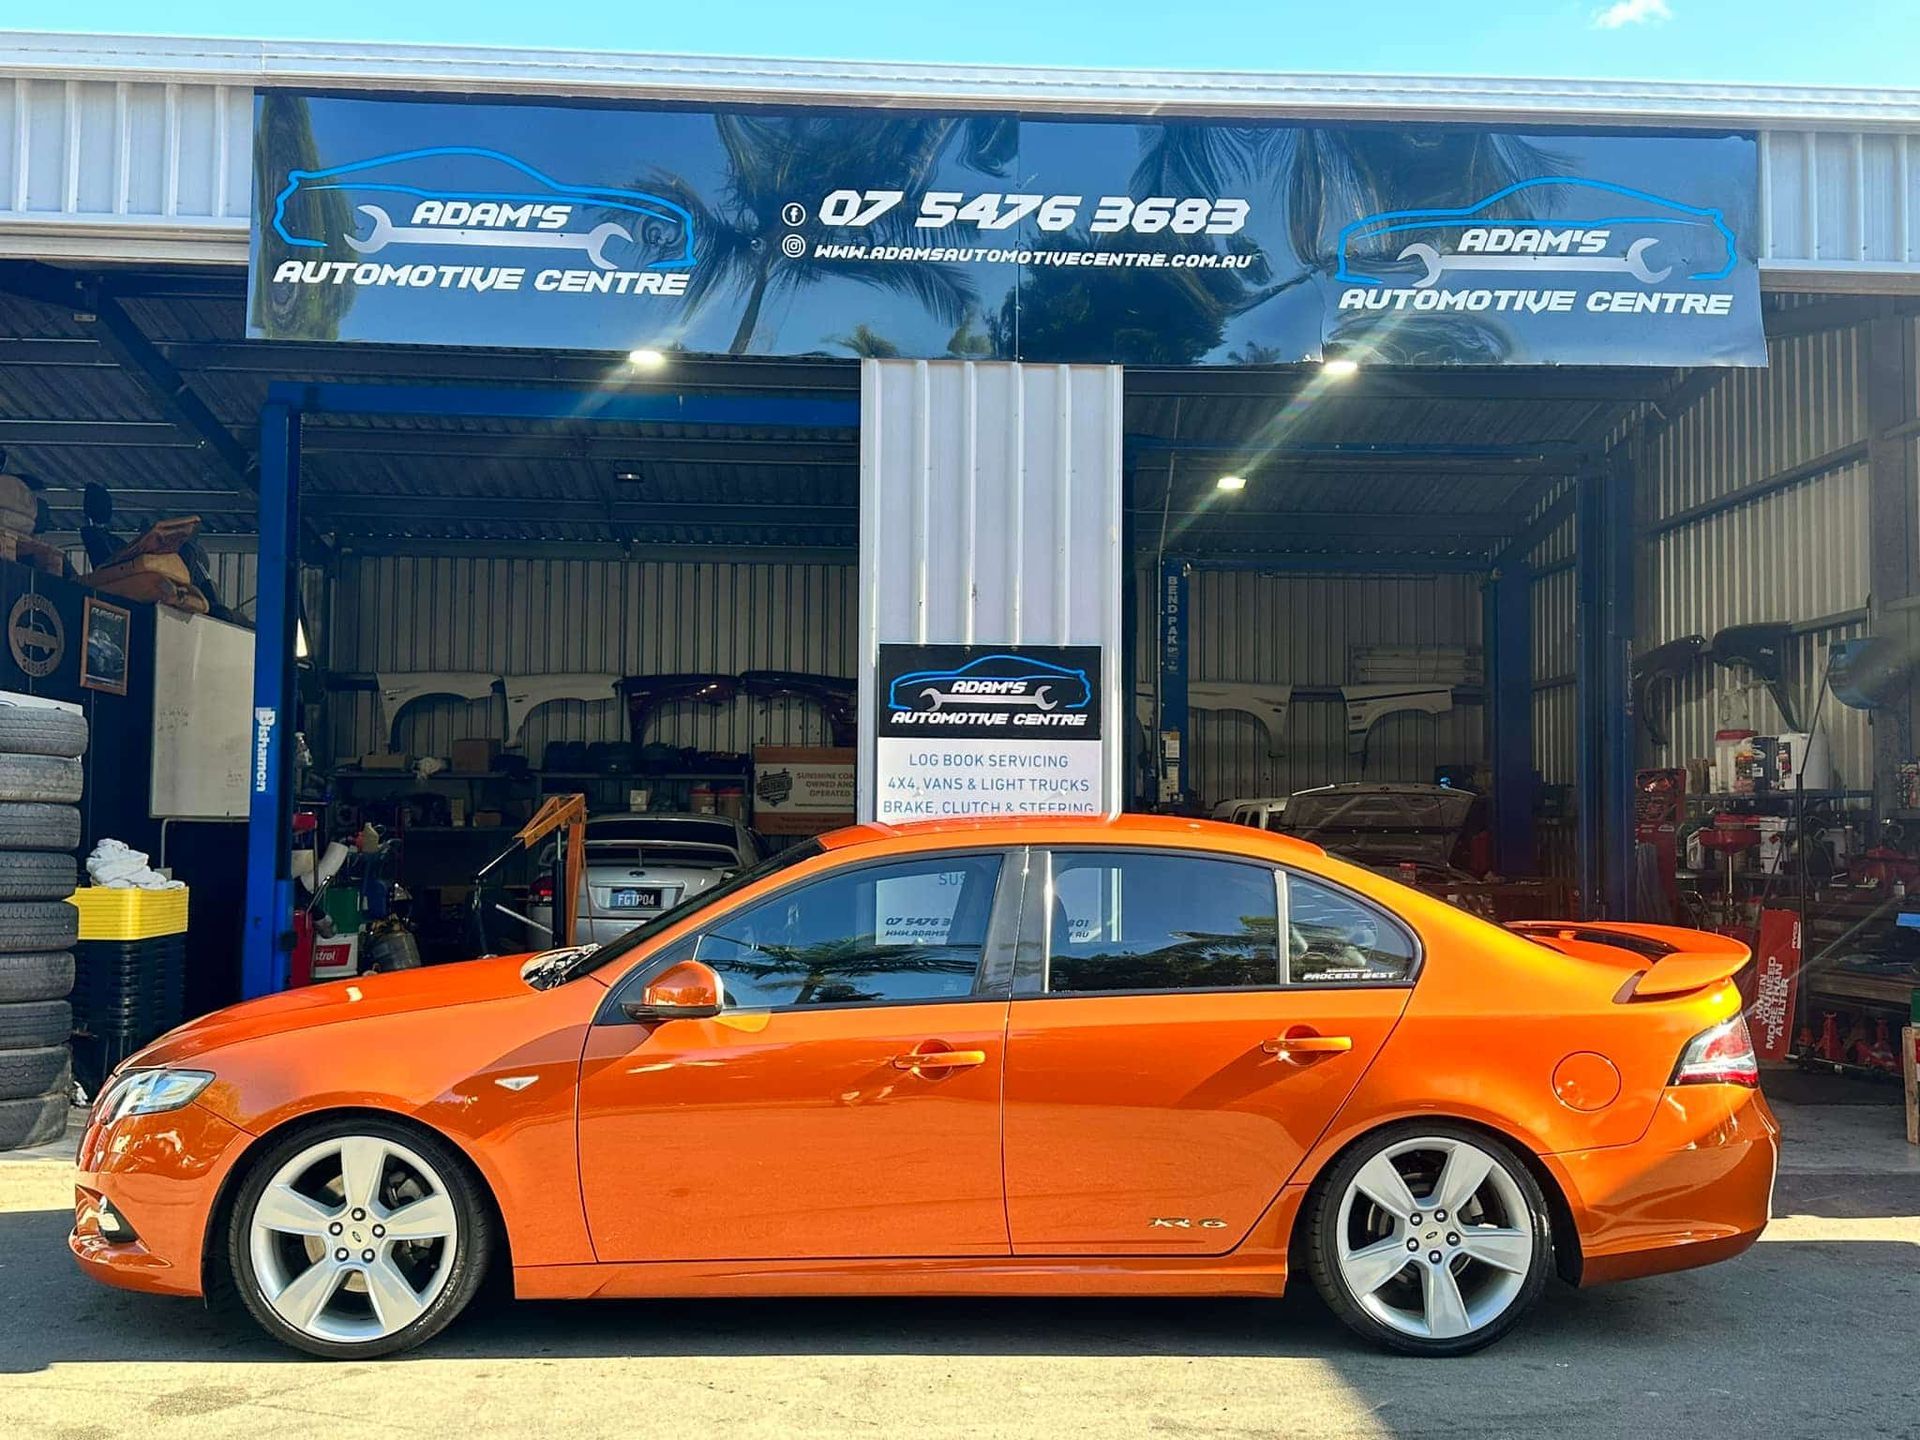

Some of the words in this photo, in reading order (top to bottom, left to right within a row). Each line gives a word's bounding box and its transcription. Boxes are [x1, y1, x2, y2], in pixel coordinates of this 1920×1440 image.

[411, 200, 573, 229] ADAM'S
[818, 189, 905, 227] 07
[914, 192, 1083, 232] 5476
[1090, 196, 1251, 235] 3683
[1457, 228, 1611, 253] ADAM'S
[813, 244, 1253, 269] WWW.ADAMSAUTOMOTIVECENTRE.COM.AU
[273, 260, 525, 293] AUTOMOTIVE
[533, 269, 690, 296] CENTRE
[1339, 288, 1577, 315] AUTOMOTIVE
[1585, 291, 1734, 315] CENTRE
[951, 680, 1028, 694] ADAM'S
[891, 711, 1009, 726] AUTOMOTIVE
[1013, 713, 1088, 726] CENTRE
[909, 753, 939, 767] LOG
[943, 754, 984, 768] BOOK
[988, 754, 1069, 768] SERVICING
[923, 777, 963, 790] VANS
[967, 778, 976, 790] &
[981, 778, 1025, 791] LIGHT
[1029, 778, 1090, 792] TRUCKS
[883, 800, 938, 814] BRAKE,
[942, 801, 1000, 814] CLUTCH
[1765, 956, 1776, 995] NEED
[1771, 963, 1783, 1005] THAN
[1755, 974, 1767, 1020] WHEN
[1761, 995, 1772, 1025] YOU
[1777, 978, 1789, 1024] FILTER
[1765, 1006, 1778, 1050] MORE
